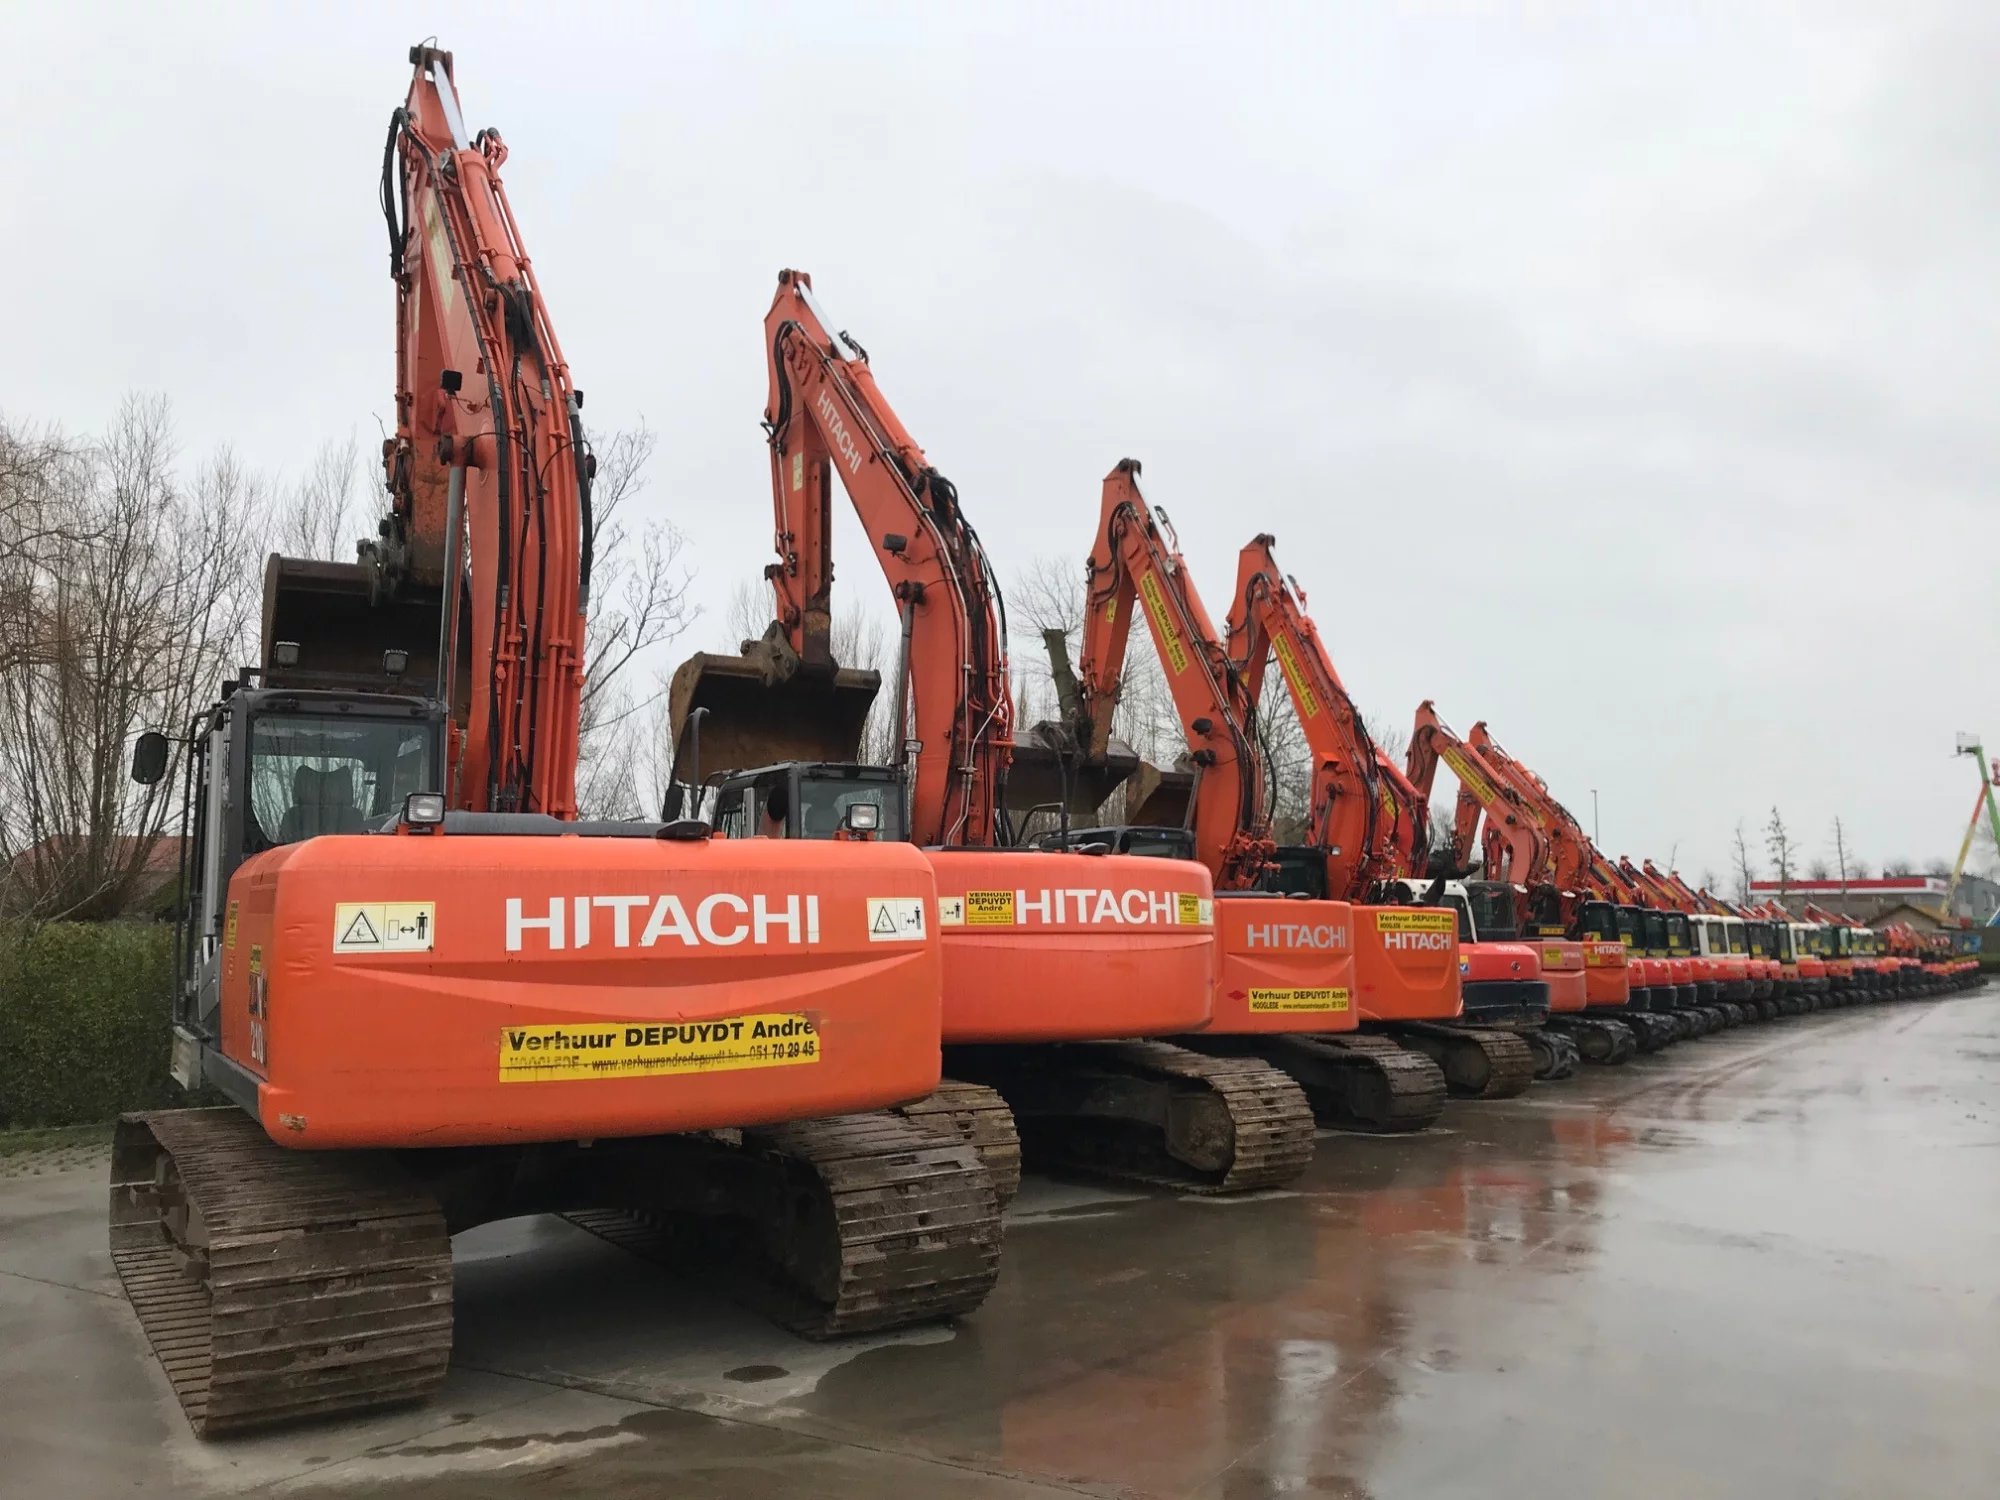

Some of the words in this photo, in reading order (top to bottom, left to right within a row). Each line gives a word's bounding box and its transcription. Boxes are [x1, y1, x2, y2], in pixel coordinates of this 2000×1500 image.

[818, 389, 862, 474] HITACHI
[1016, 890, 1180, 924] HITACHI
[1380, 914, 1410, 922] Verhuur
[506, 893, 819, 951] HITACHI
[1248, 924, 1346, 948] HITACHI
[1385, 932, 1452, 950] HITACHI
[1252, 991, 1291, 999] Verhuur
[1294, 990, 1330, 999] DEPUYDT
[508, 1031, 616, 1050] Verhuur
[626, 1022, 744, 1047] DEPUYDT
[750, 1044, 768, 1060] 051
[772, 1042, 784, 1059] 70
[788, 1042, 800, 1058] 29
[802, 1040, 814, 1056] 45
